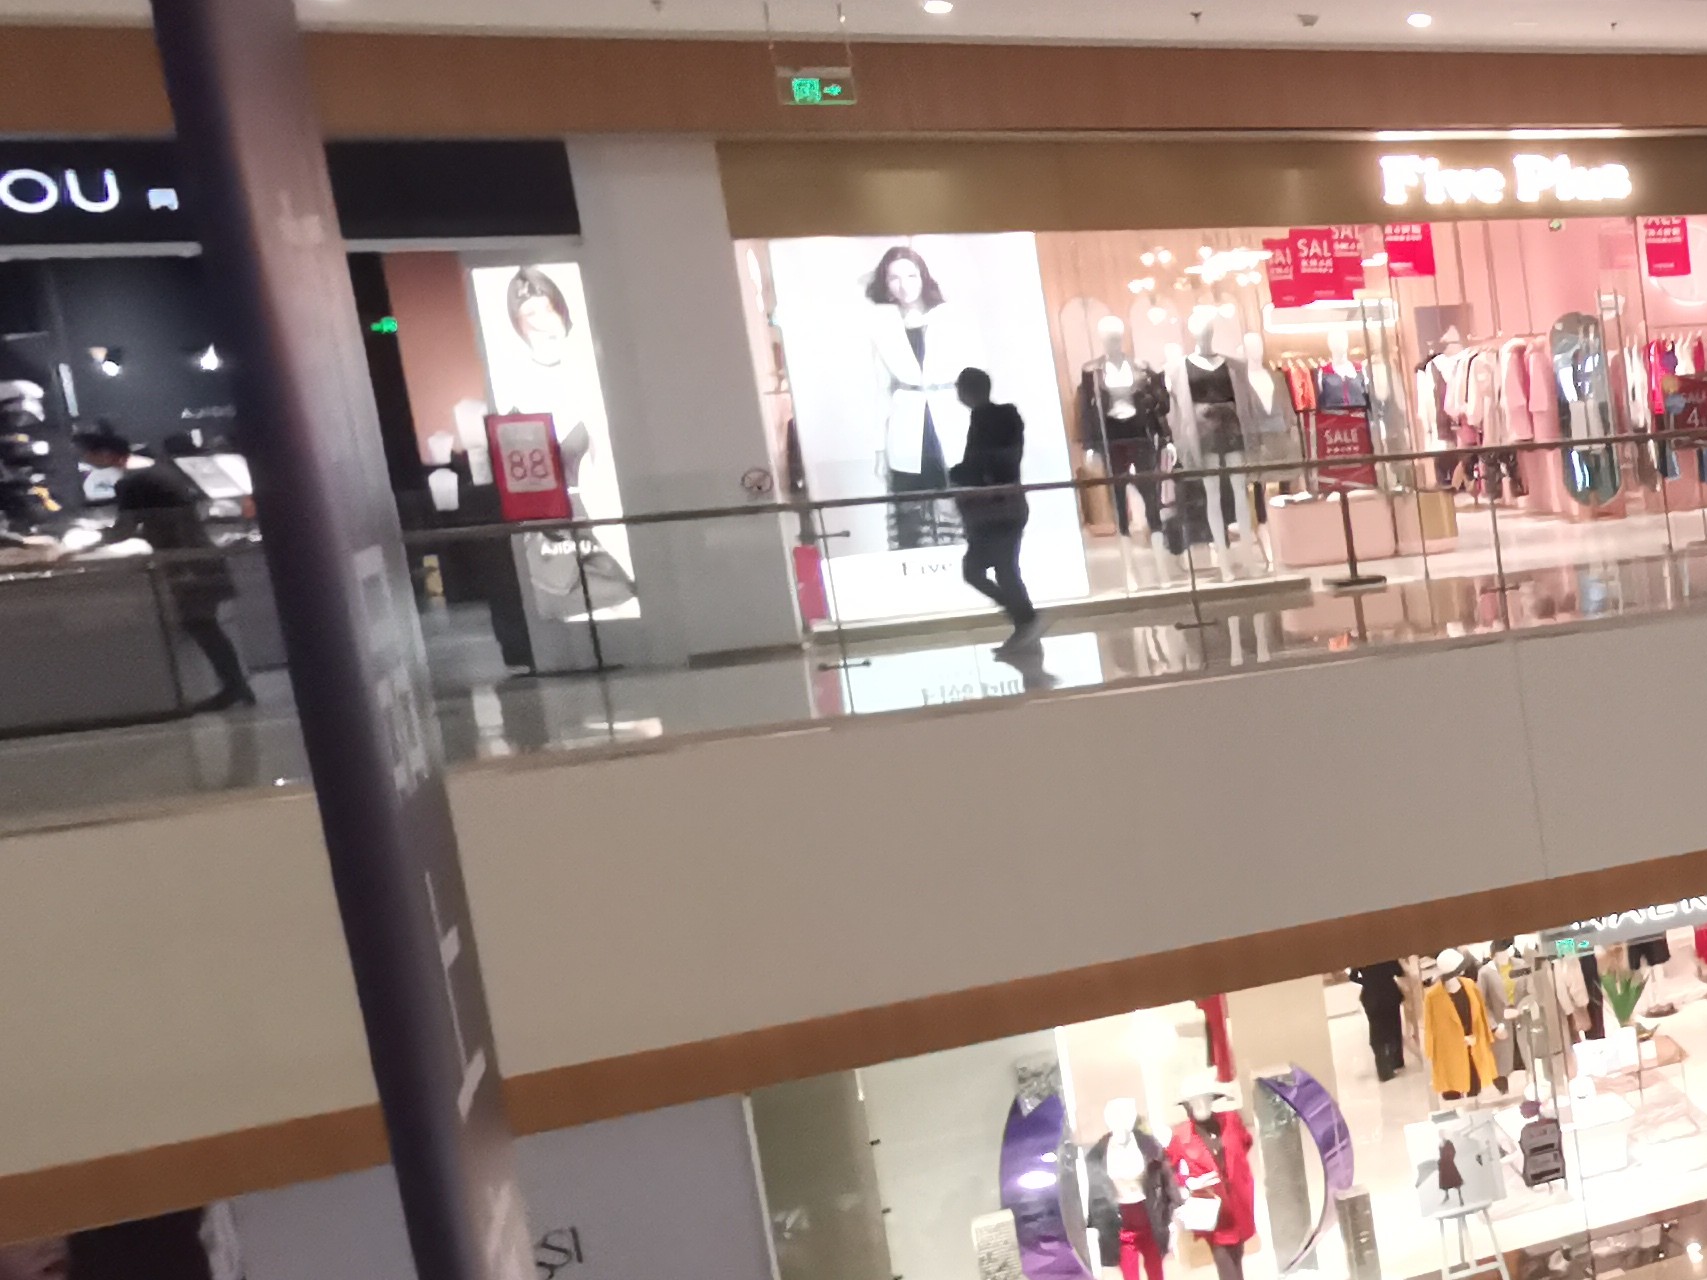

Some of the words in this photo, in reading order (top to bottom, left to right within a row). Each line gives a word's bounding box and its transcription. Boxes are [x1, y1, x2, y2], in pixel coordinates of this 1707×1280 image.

[1379, 154, 1505, 205] Five
[1513, 153, 1632, 202] Plus
[1324, 428, 1359, 445] SALE
